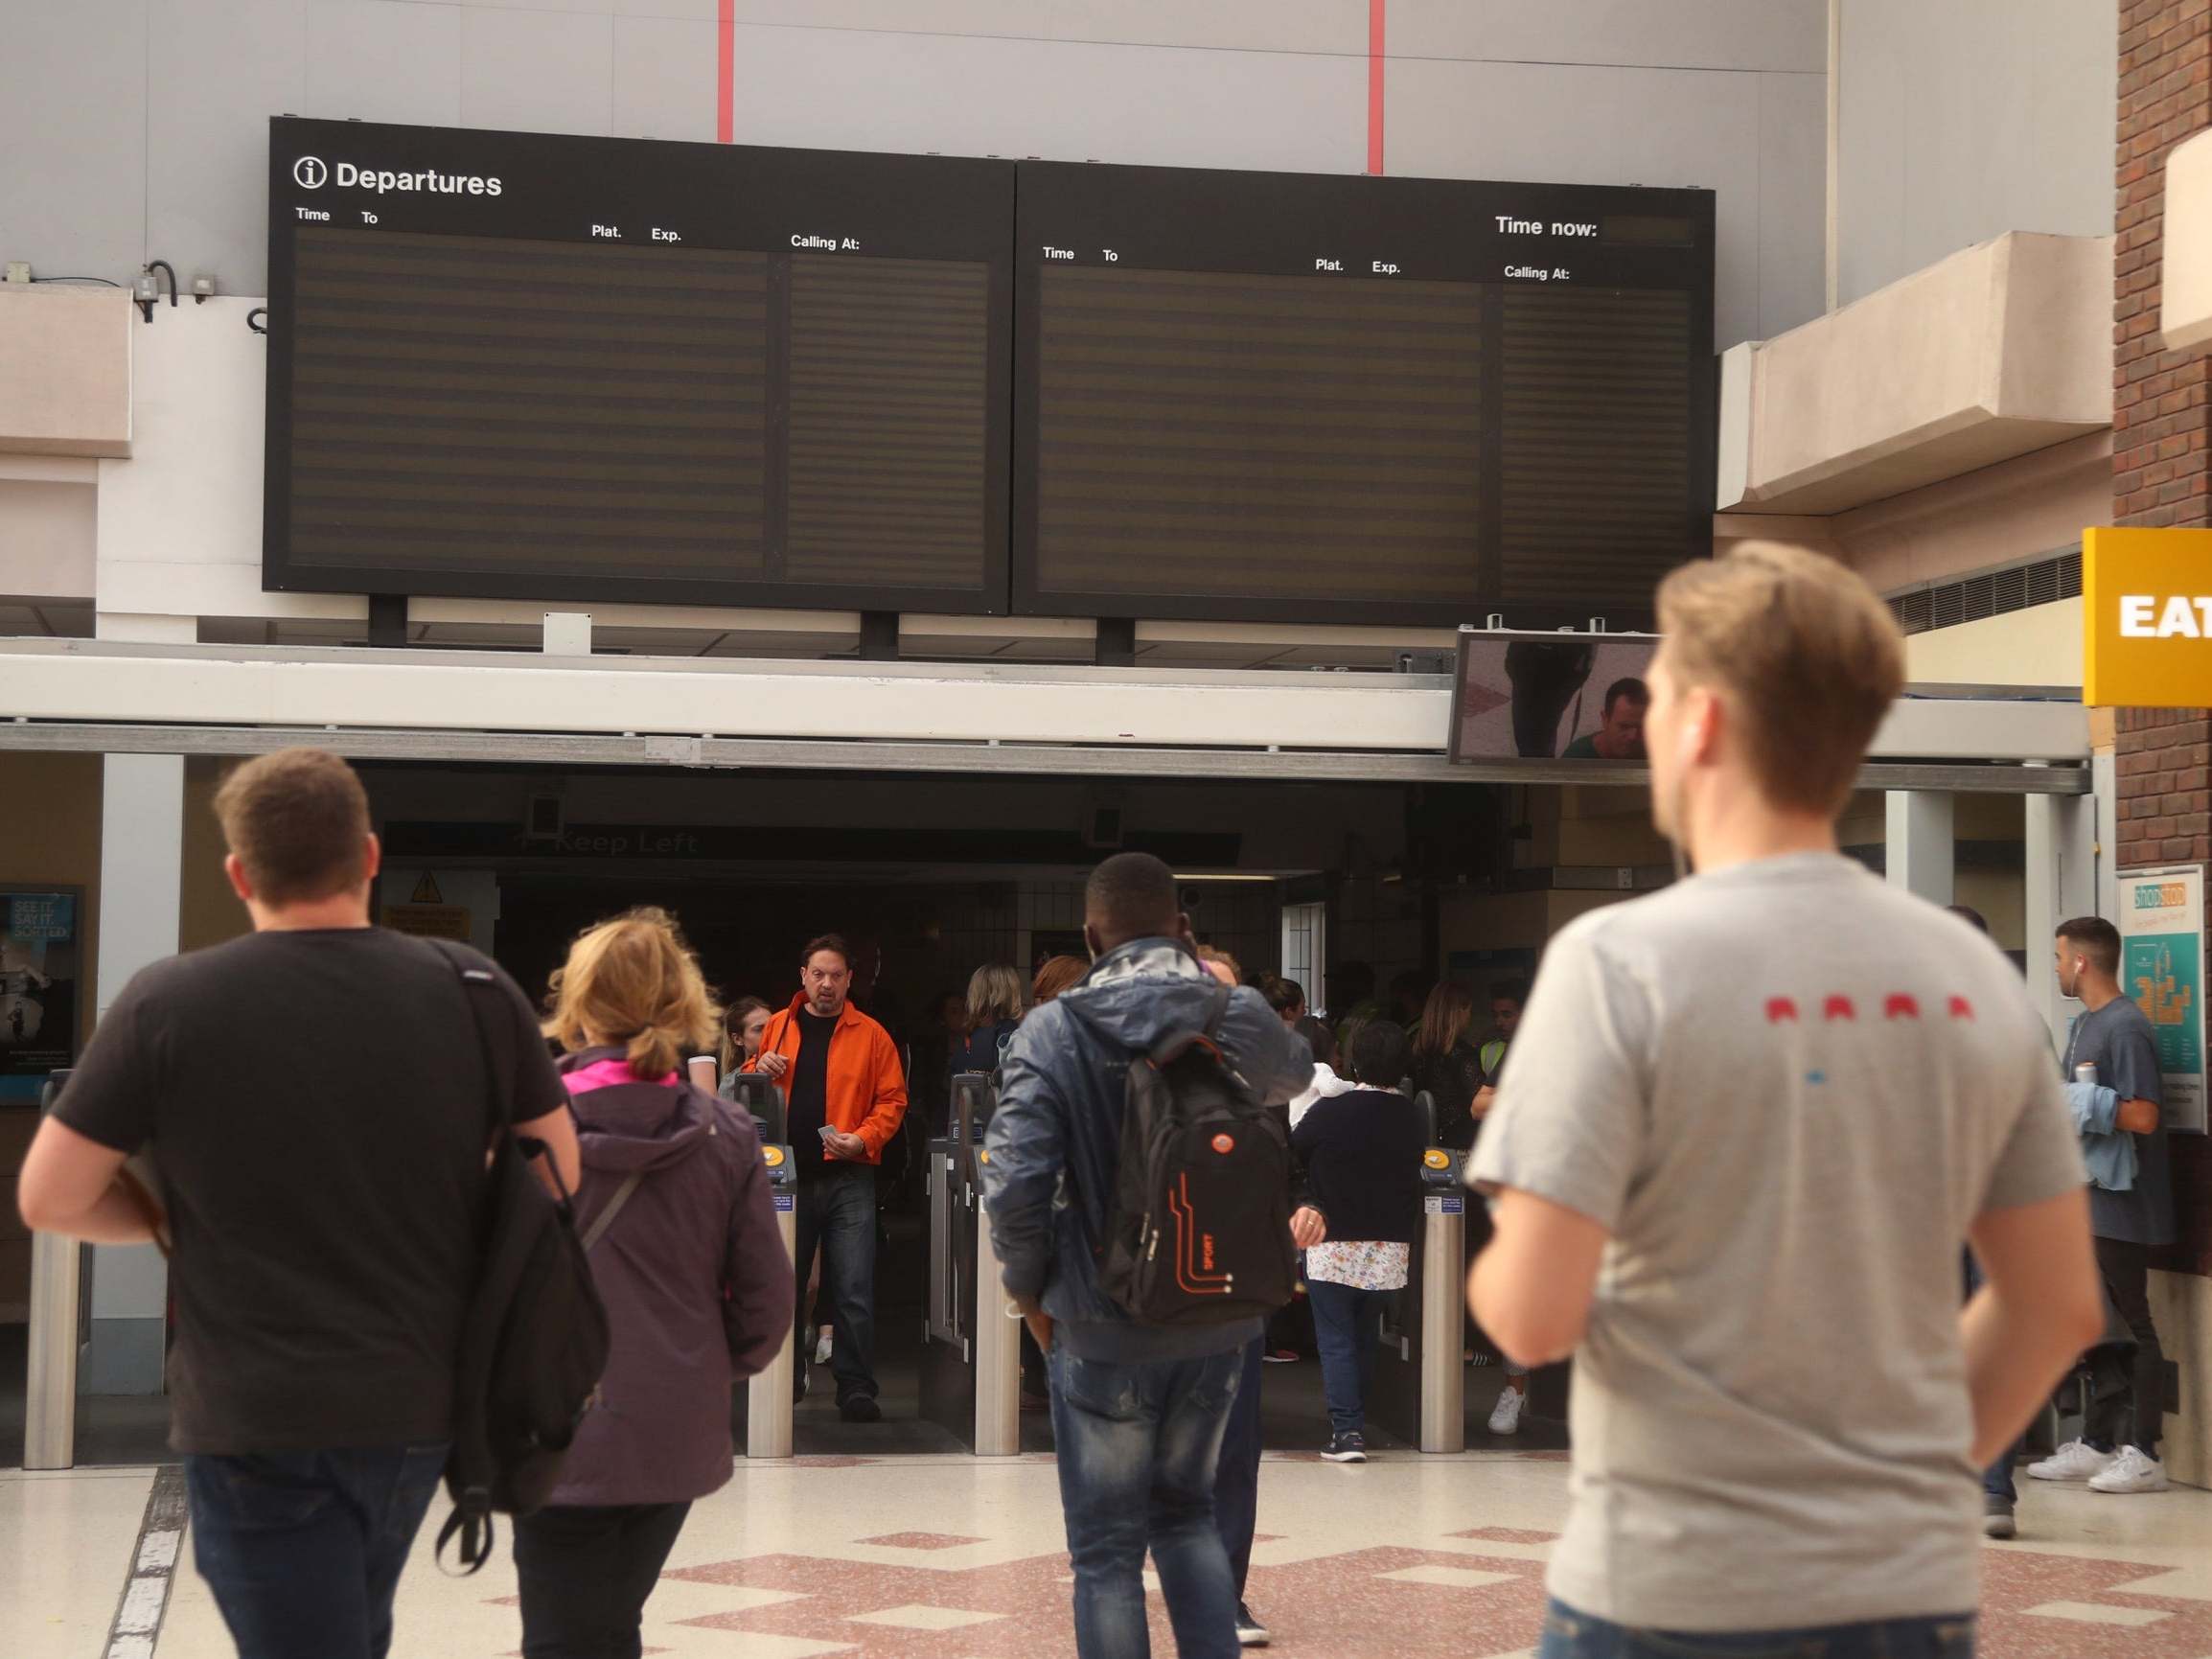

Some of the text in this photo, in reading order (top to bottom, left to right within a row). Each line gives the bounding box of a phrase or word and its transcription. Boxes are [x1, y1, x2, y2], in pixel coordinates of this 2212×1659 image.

[336, 162, 502, 196] Departures
[295, 206, 331, 221] Time
[360, 211, 379, 224] To
[591, 224, 622, 238] Plat.
[1494, 216, 1598, 238] Time now:
[651, 227, 682, 243] Exp.
[791, 234, 860, 252] Calling At:
[1042, 246, 1075, 260] Time
[1102, 249, 1118, 262] To
[1315, 258, 1345, 271] Plat.
[1371, 261, 1401, 275] Exp.
[1504, 265, 1570, 282] Calling At:
[554, 830, 700, 856] Keep Left
[14, 900, 38, 912] SEE
[14, 912, 38, 925] SAY
[1203, 1233, 1214, 1270] SPORT
